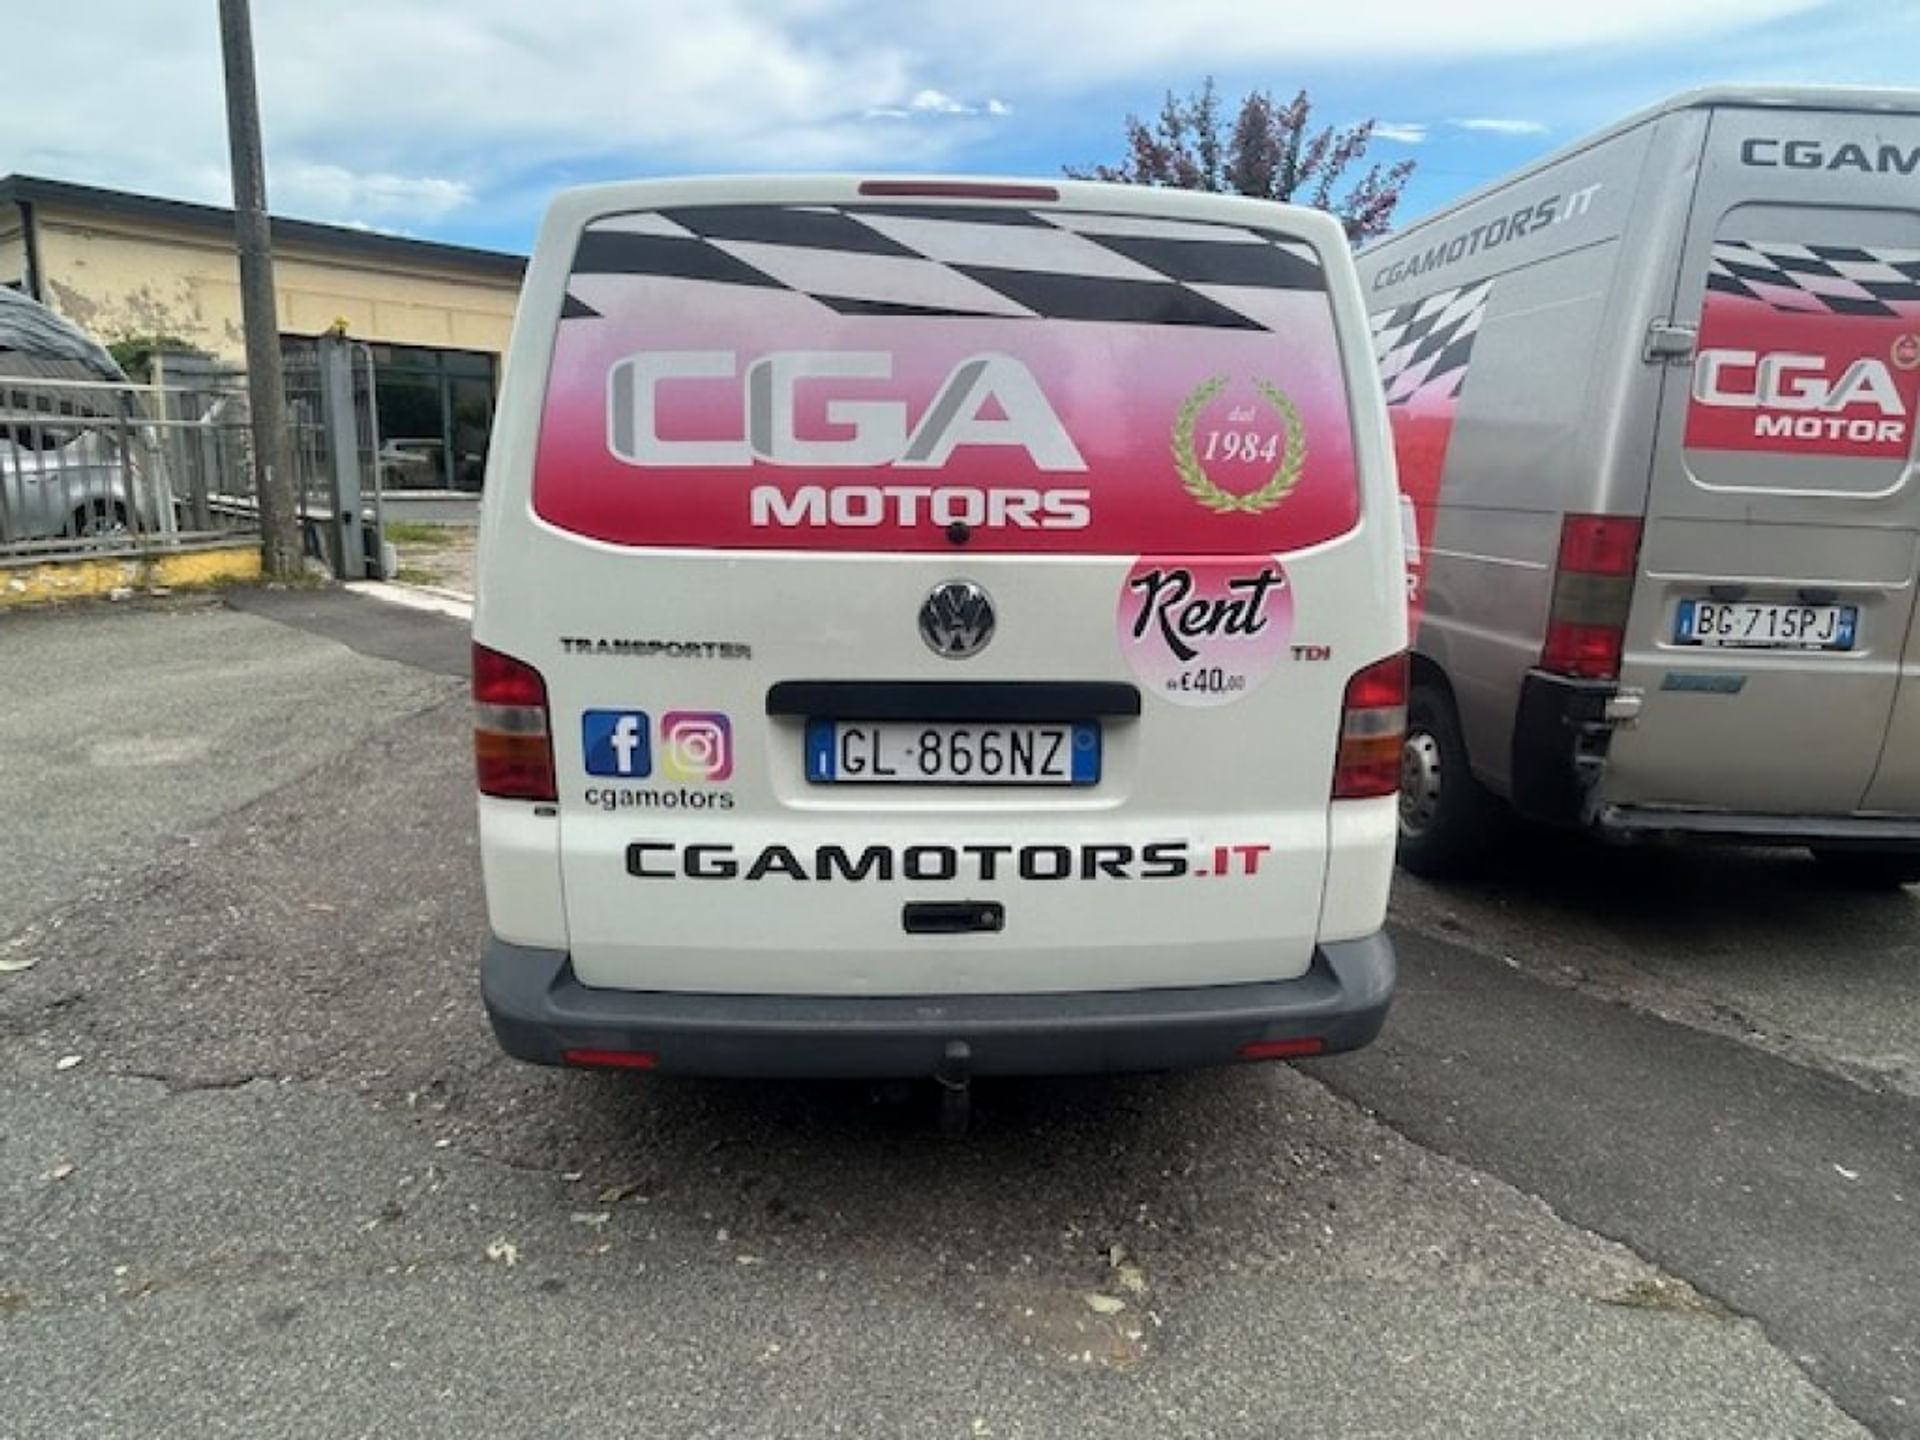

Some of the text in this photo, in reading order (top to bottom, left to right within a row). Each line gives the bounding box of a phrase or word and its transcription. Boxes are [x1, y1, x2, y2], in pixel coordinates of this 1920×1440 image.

[1373, 183, 1602, 291] CGAMOTORS.IT
[1694, 349, 1906, 415] CGA
[606, 350, 1090, 471] CGA
[1754, 415, 1906, 442] MOTOR
[1204, 431, 1279, 463] 1984
[750, 484, 1090, 529] MOTORS
[1131, 569, 1282, 661] Rent
[1697, 604, 1836, 640] BG 715PJ
[841, 728, 1064, 776] GL 866NZ
[584, 788, 735, 810] cgamotors
[626, 842, 1271, 881] CGAMOTORS.IT
